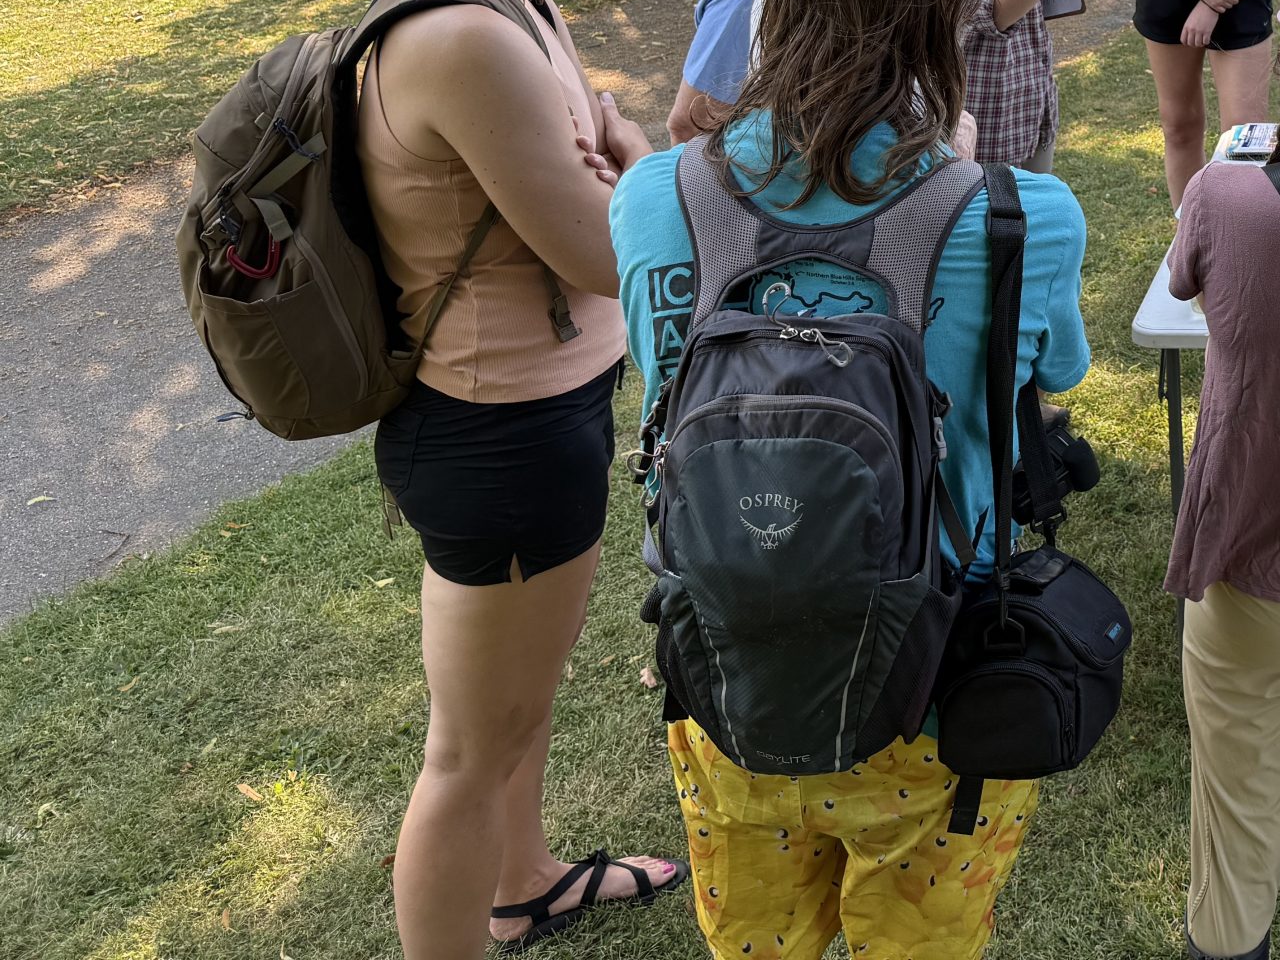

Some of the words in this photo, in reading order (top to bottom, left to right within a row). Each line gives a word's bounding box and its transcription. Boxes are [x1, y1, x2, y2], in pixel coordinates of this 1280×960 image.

[806, 271, 830, 279] Northern
[653, 266, 694, 308] IC
[739, 493, 805, 513] OSPREY
